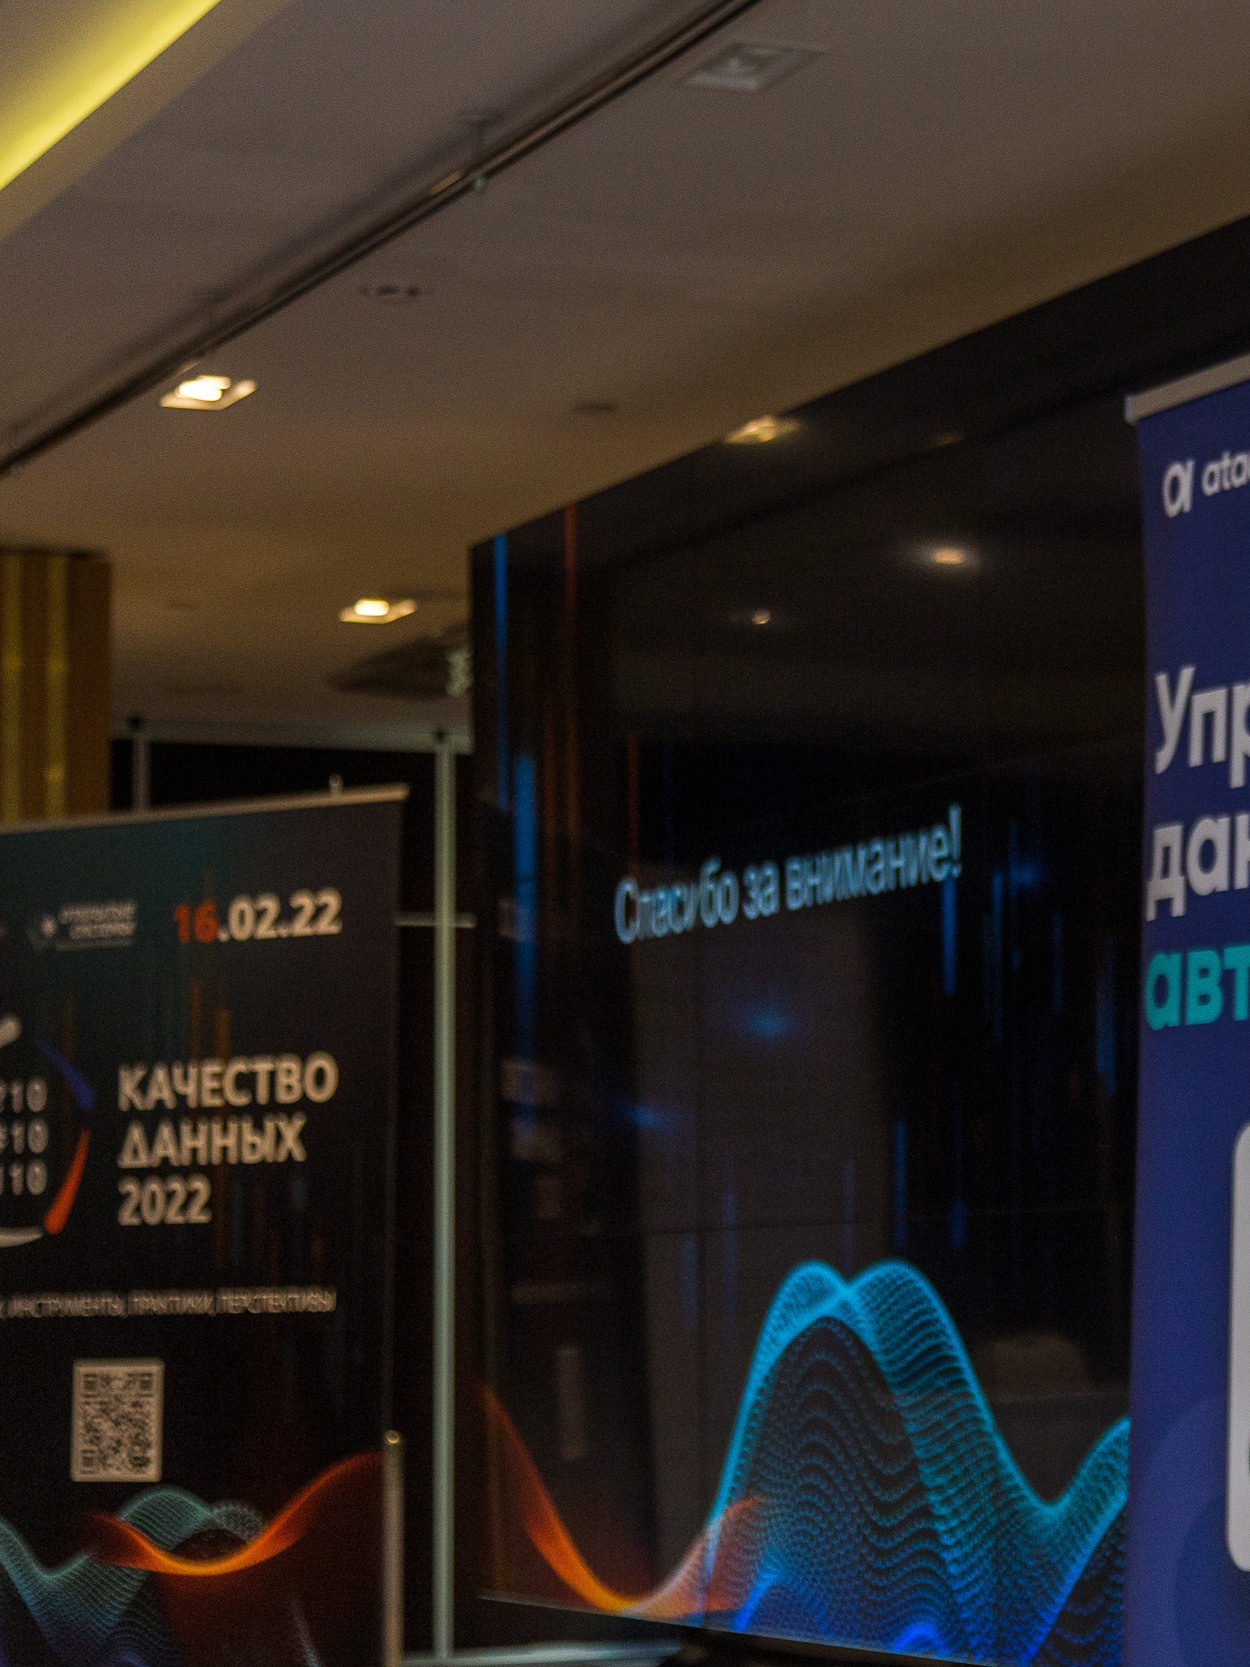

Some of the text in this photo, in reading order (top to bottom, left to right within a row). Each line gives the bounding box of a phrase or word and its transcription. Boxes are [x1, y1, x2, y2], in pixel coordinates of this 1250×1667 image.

[614, 803, 963, 945] Спасибо за внимание!
[173, 887, 343, 944] 16.02.22
[117, 1052, 339, 1112] КАЧЕСТВО
[117, 1112, 306, 1168] ДАННЫХ
[117, 1174, 212, 1226] 2022
